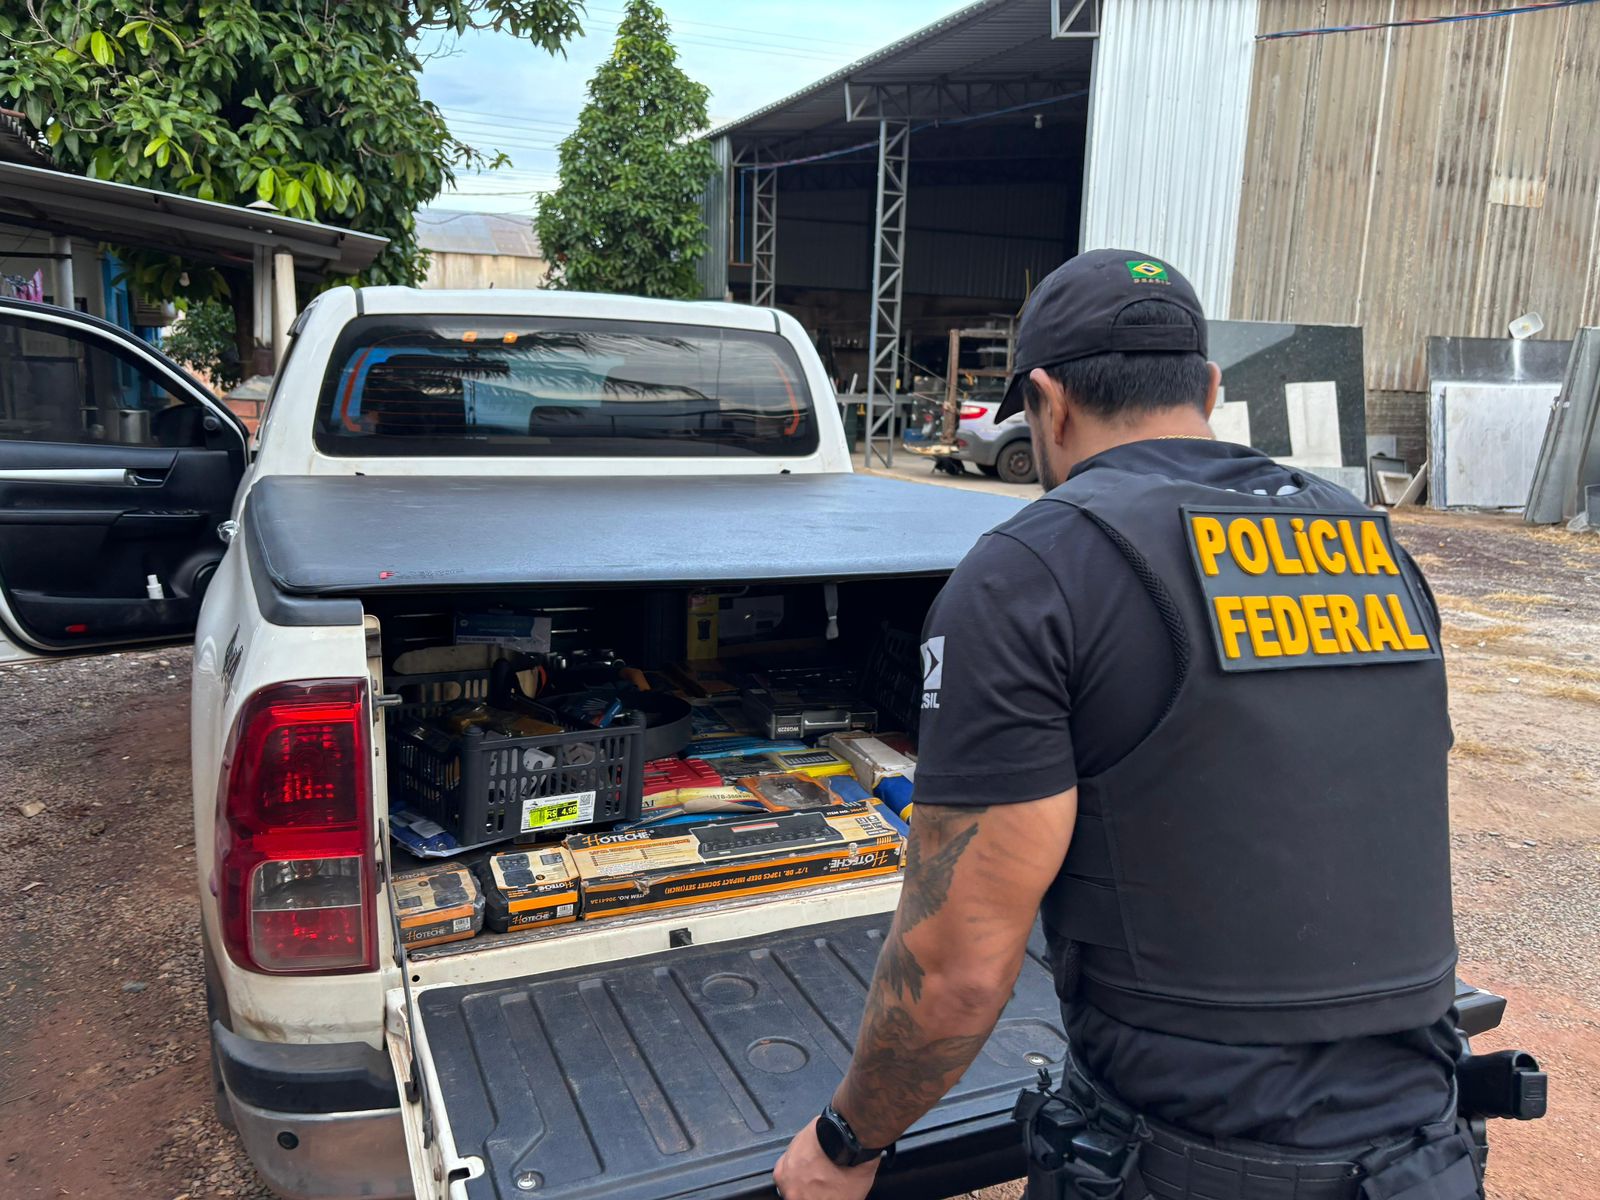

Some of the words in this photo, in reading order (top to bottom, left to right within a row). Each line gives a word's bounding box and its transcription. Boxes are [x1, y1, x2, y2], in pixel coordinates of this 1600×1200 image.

[1213, 593, 1430, 659] FEDERAL
[921, 692, 940, 709] SIL
[582, 832, 651, 846] HOTECHE
[828, 850, 889, 868] HOTECHE
[697, 881, 721, 889] SOCKET
[722, 877, 746, 886] IMPACT
[512, 912, 551, 925] HOTECHE
[406, 928, 447, 941] HOTECHE
